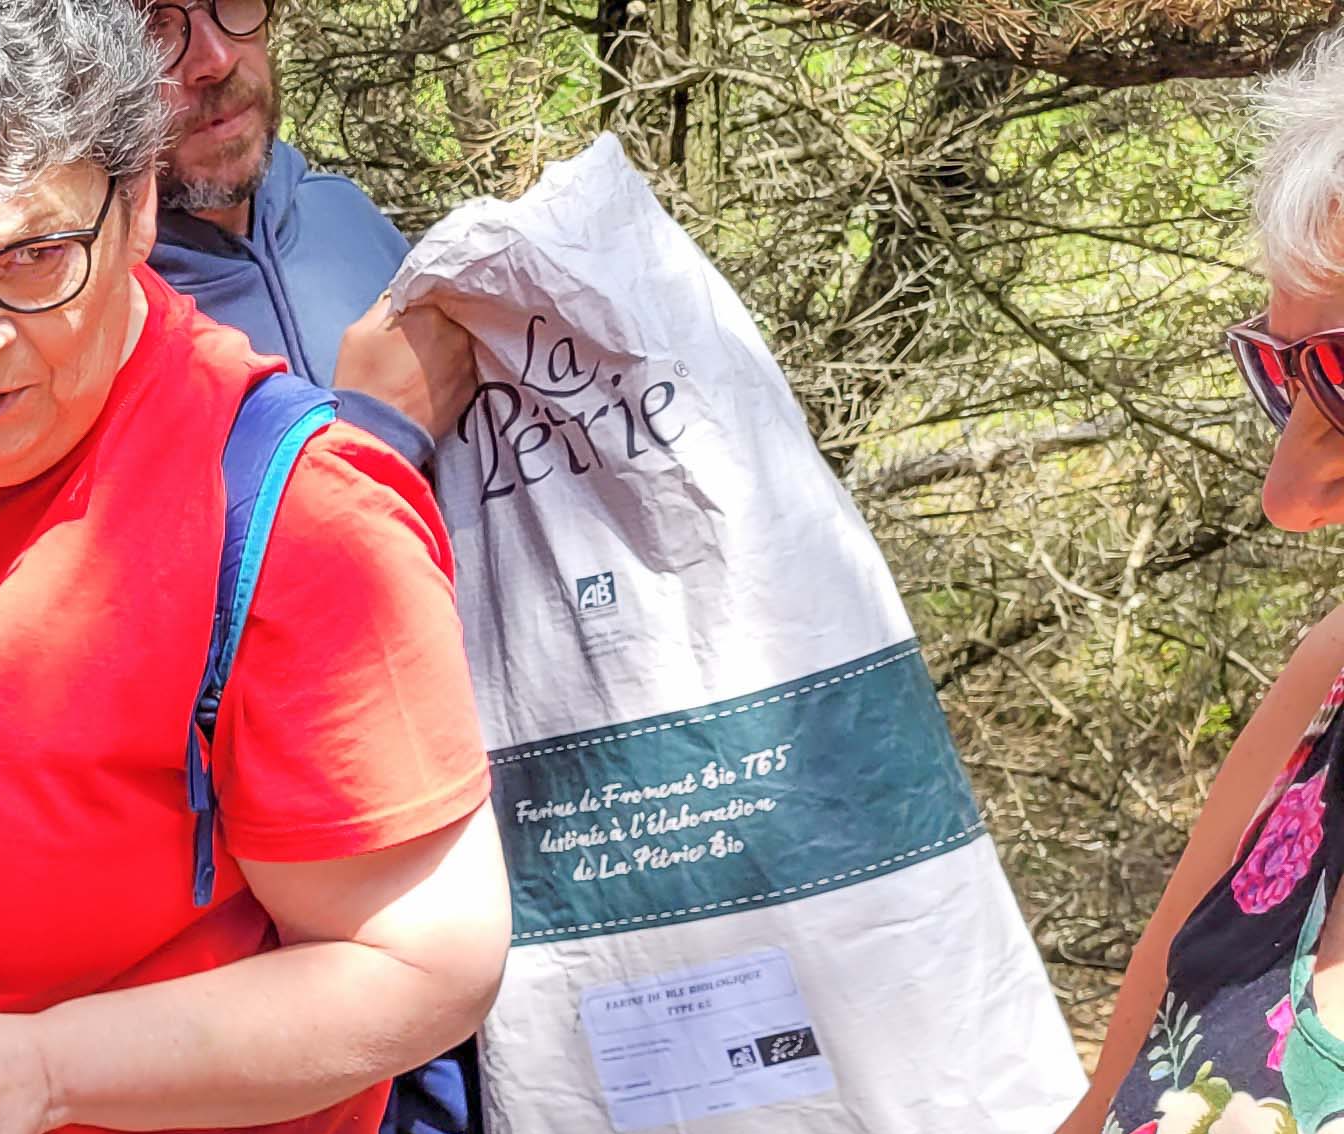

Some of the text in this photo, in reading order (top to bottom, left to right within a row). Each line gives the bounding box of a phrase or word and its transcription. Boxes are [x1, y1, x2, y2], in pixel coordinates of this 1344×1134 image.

[520, 315, 600, 397] La
[700, 761, 736, 789] Bio
[740, 744, 792, 779] T65
[599, 853, 632, 879] La
[708, 830, 744, 858] Bio
